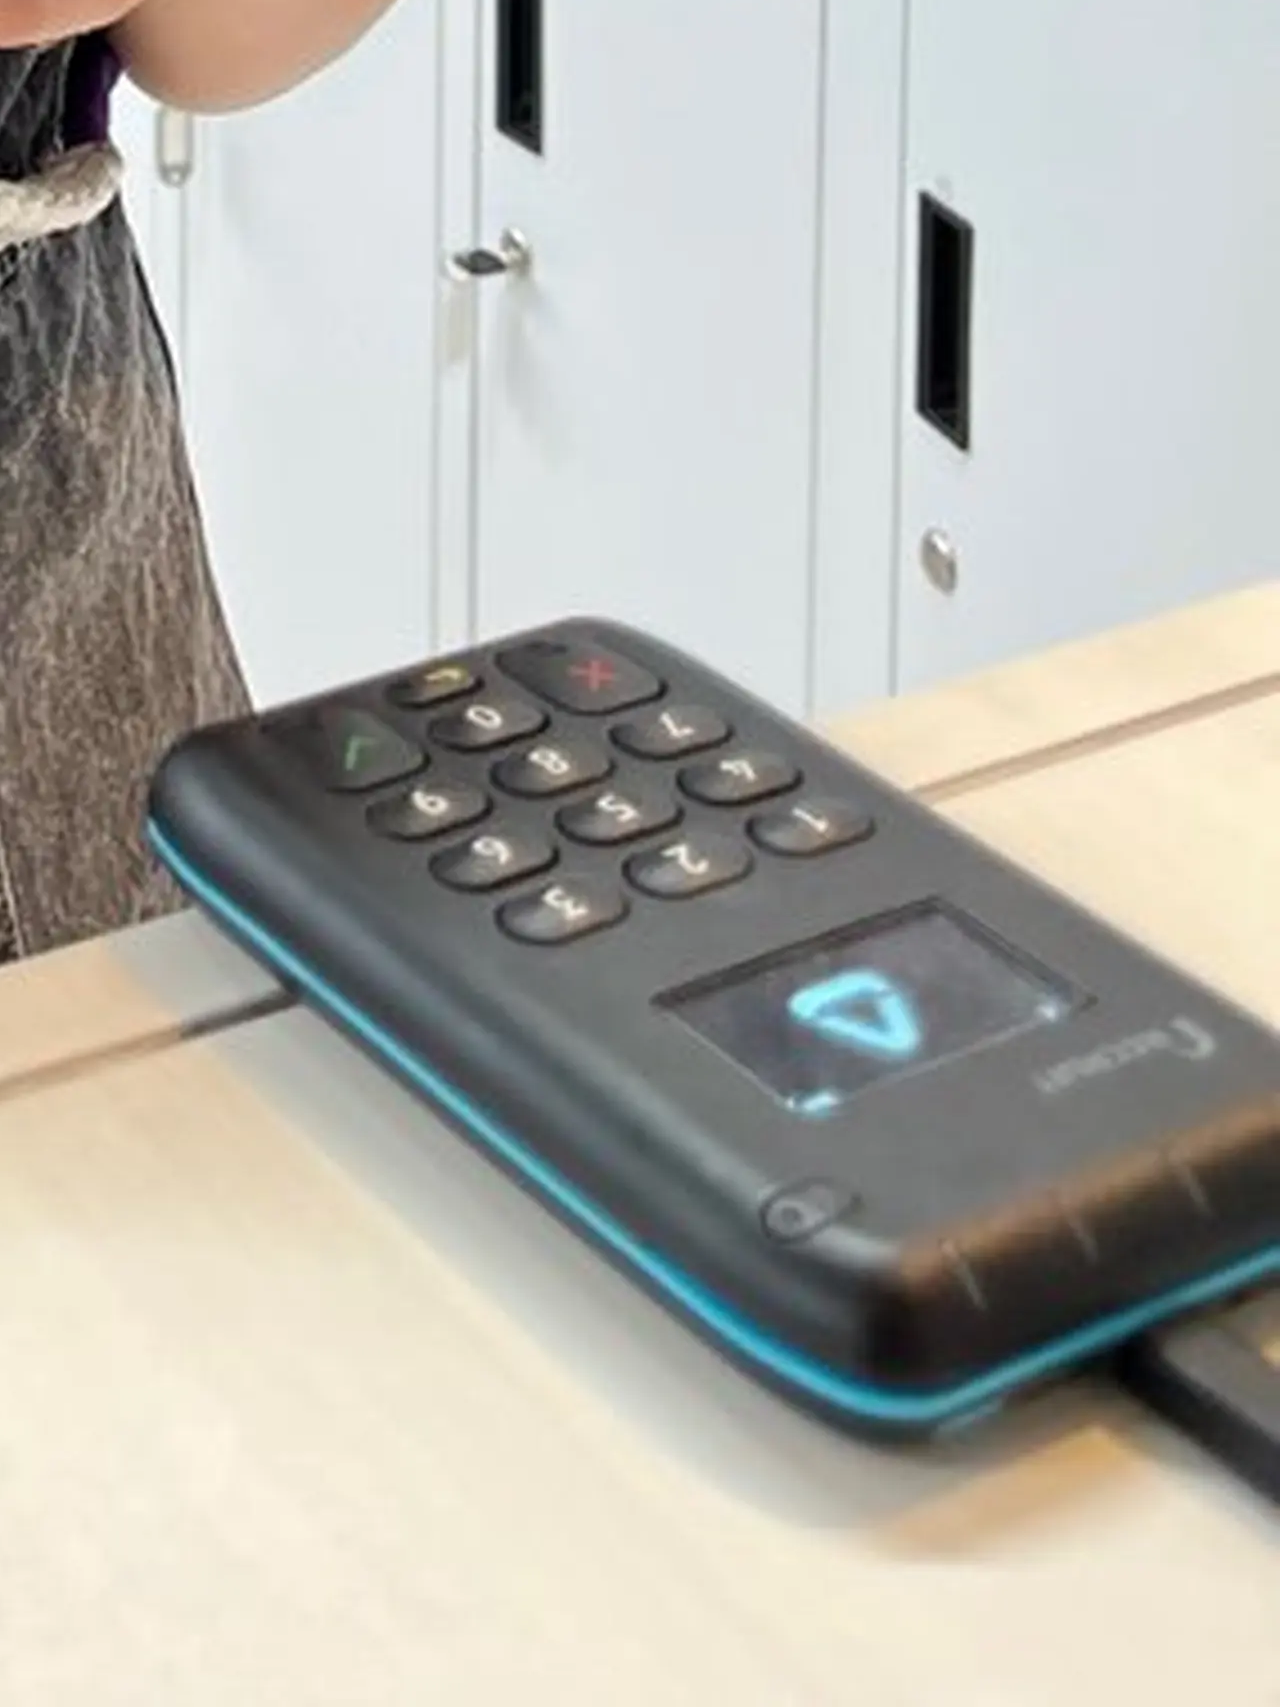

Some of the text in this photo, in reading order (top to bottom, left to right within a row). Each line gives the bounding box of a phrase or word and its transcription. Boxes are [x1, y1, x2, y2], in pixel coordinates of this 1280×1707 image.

[465, 704, 503, 730] 0
[659, 712, 696, 738] 7
[527, 746, 571, 775] 8
[596, 792, 639, 823] 5
[661, 843, 709, 875] 2
[542, 886, 591, 921] 3
